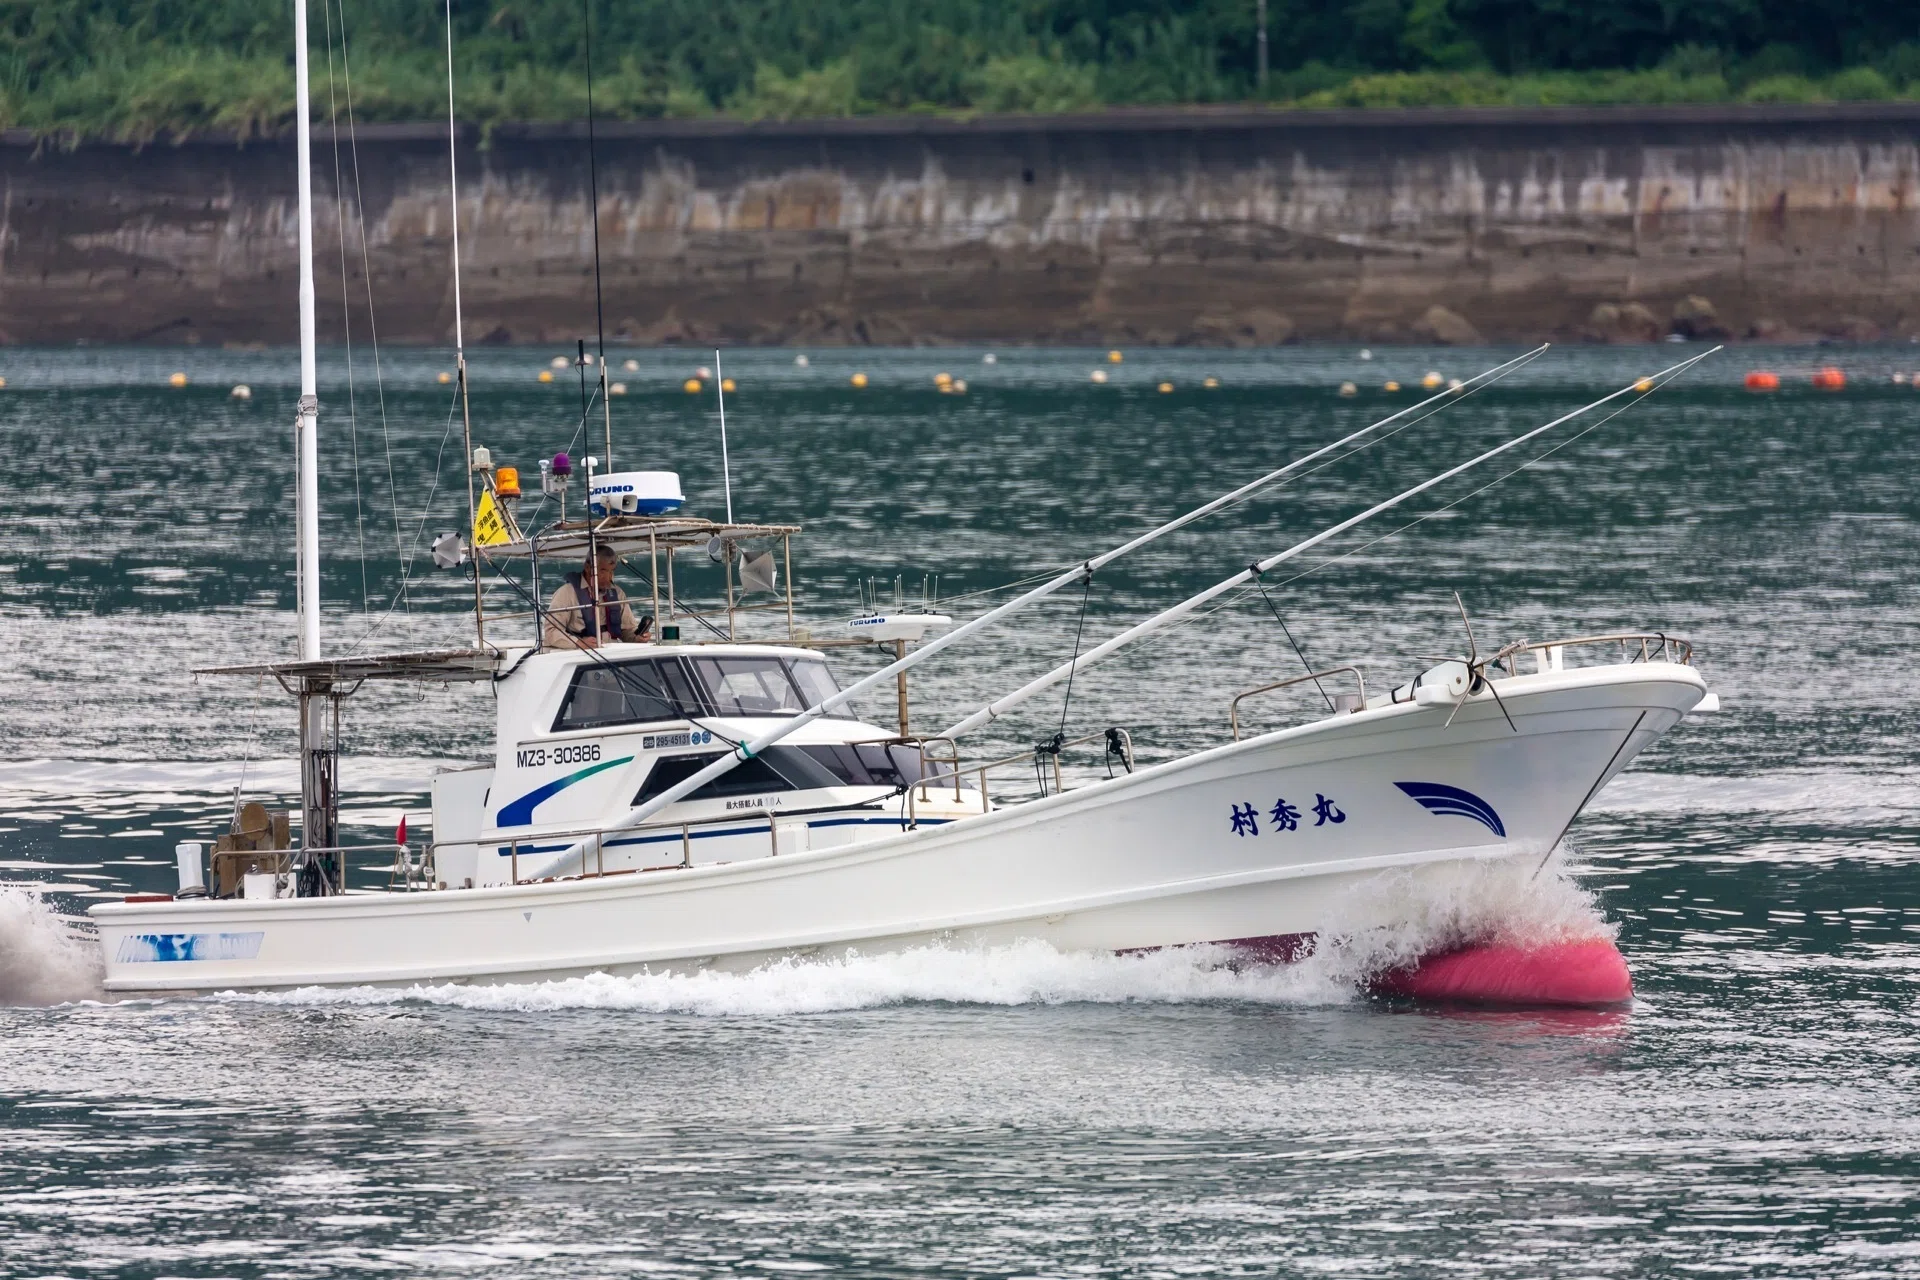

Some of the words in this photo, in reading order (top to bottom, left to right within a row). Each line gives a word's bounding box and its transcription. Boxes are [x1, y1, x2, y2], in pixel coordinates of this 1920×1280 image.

[656, 735, 690, 747] 295-45131
[517, 744, 601, 768] MZ3-30386
[1230, 793, 1346, 837] 村秀丸
